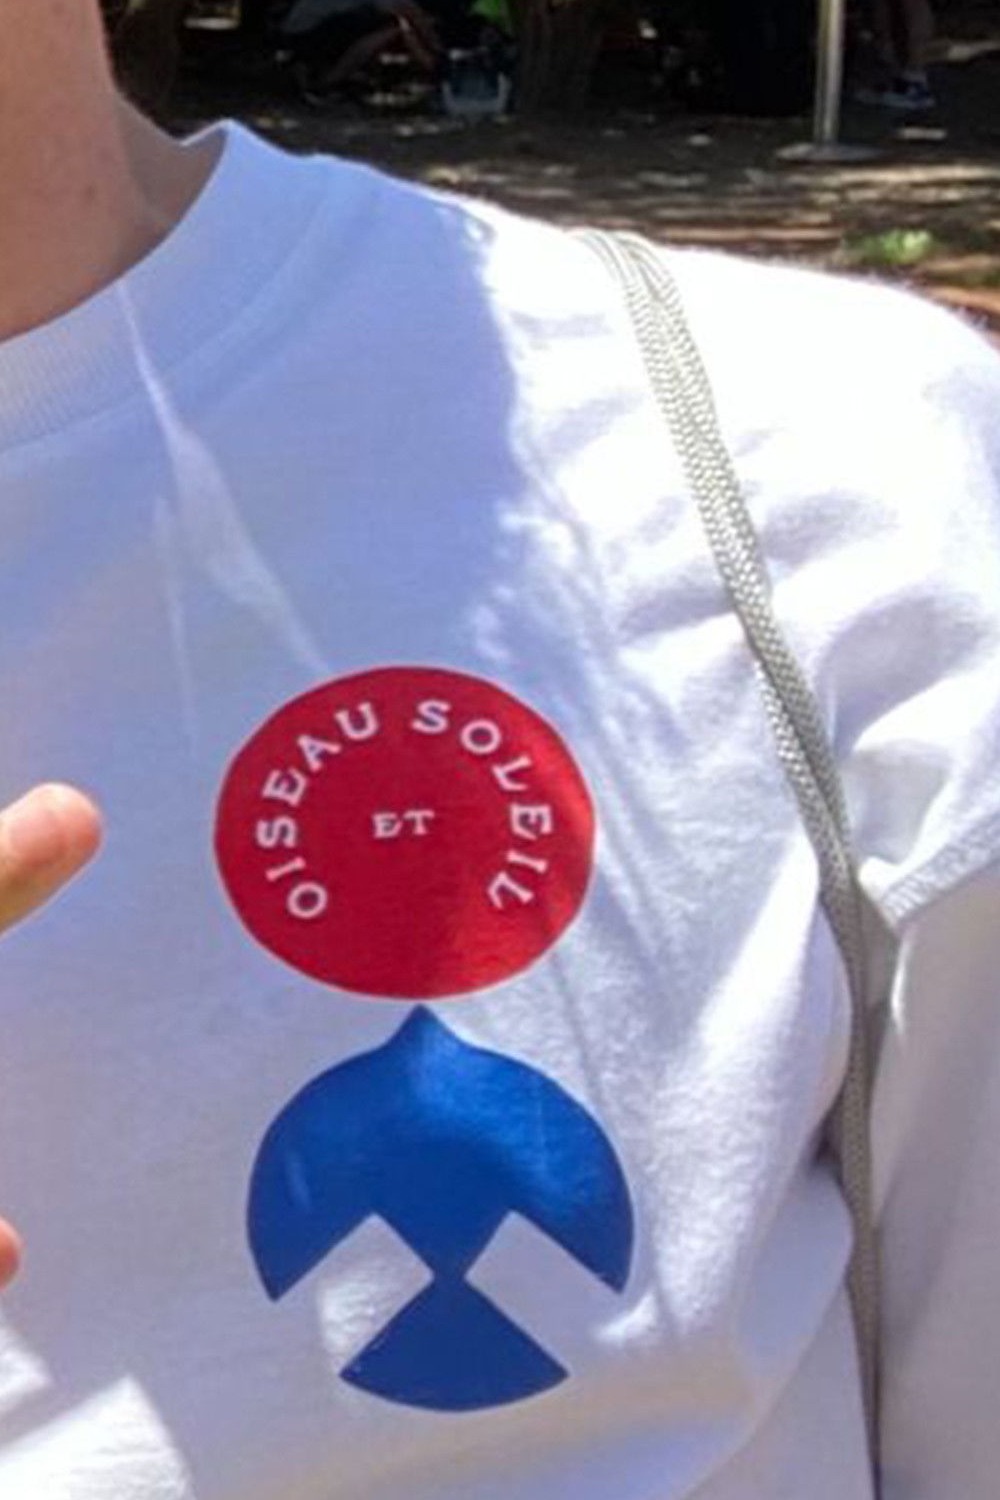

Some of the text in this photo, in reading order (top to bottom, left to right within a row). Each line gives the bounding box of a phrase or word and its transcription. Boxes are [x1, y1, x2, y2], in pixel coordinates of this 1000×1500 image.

[256, 699, 552, 919] OISEAU SOLEIL
[372, 810, 435, 839] ET
